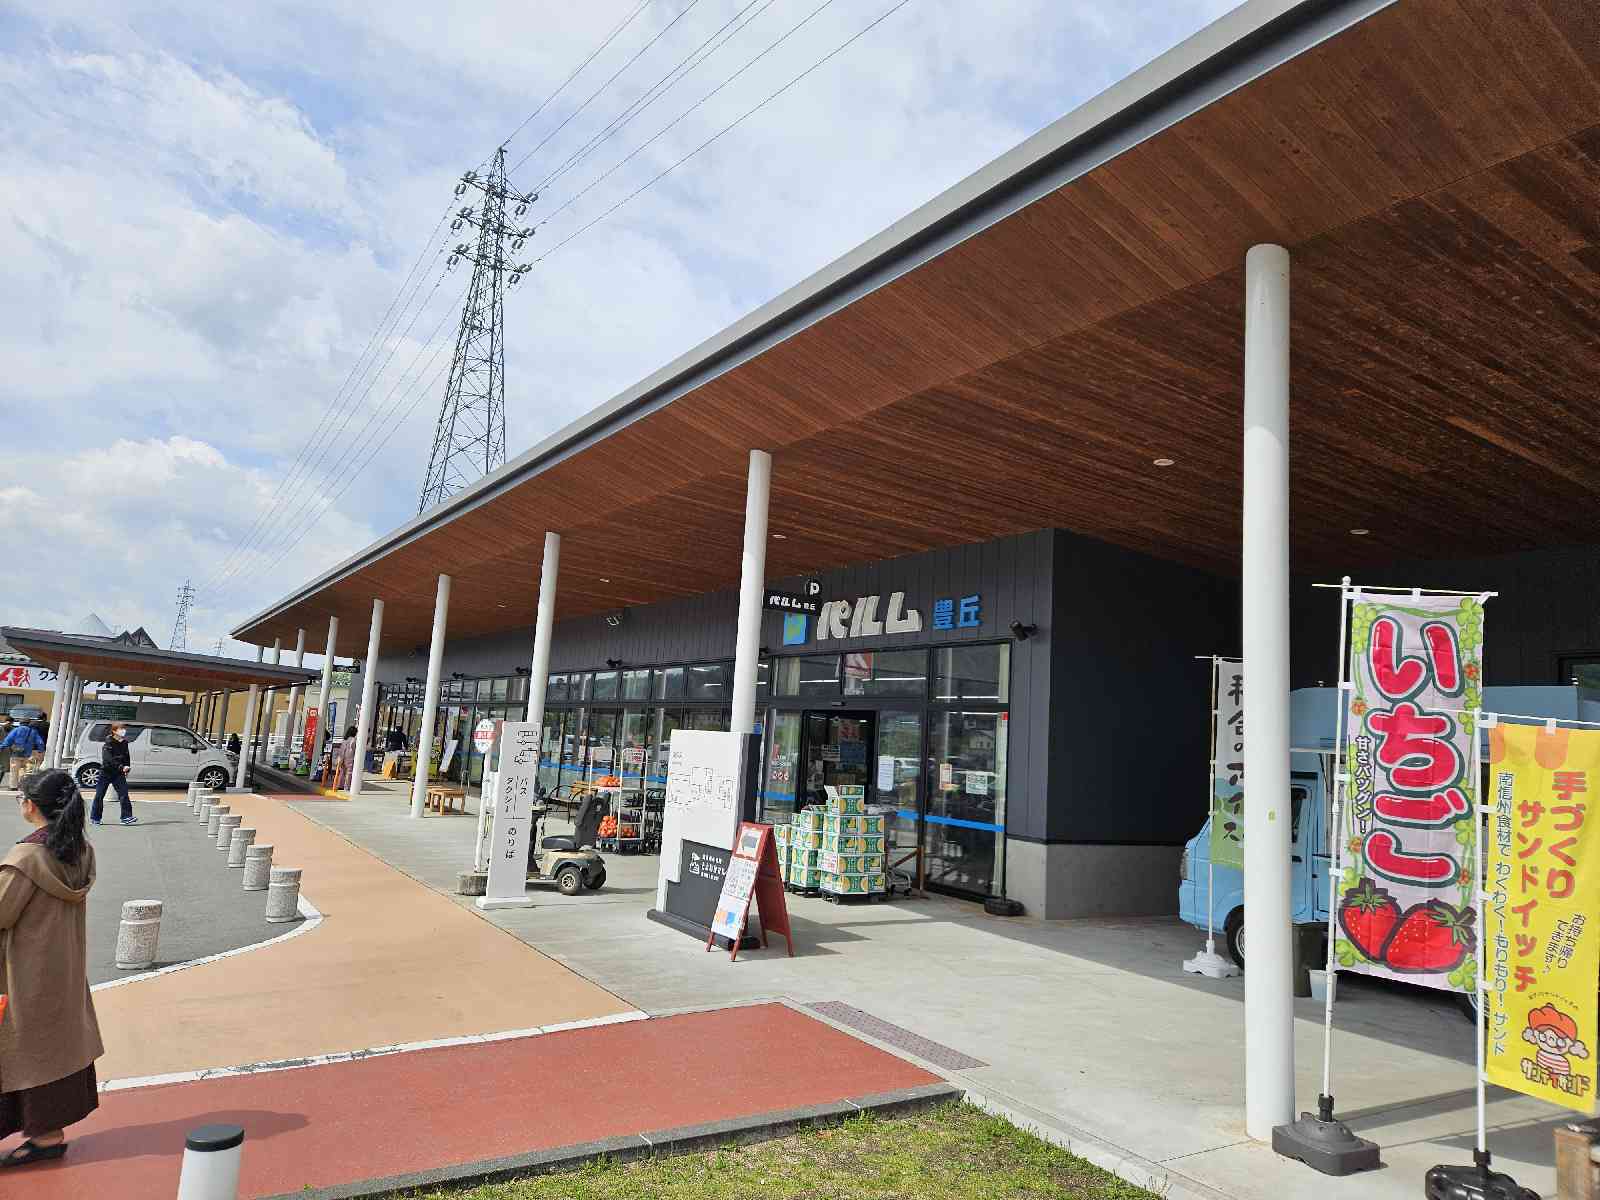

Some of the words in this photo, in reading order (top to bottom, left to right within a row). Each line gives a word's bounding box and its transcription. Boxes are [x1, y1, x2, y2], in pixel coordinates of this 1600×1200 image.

[816, 592, 923, 640] パルム
[933, 595, 982, 630] 豊丘
[1363, 613, 1474, 890] いちご
[504, 776, 513, 813] タクシー
[520, 776, 528, 796] バス
[504, 826, 518, 860] のりば
[1547, 771, 1587, 898] 手づくり
[1512, 800, 1546, 992] サンドイッチ
